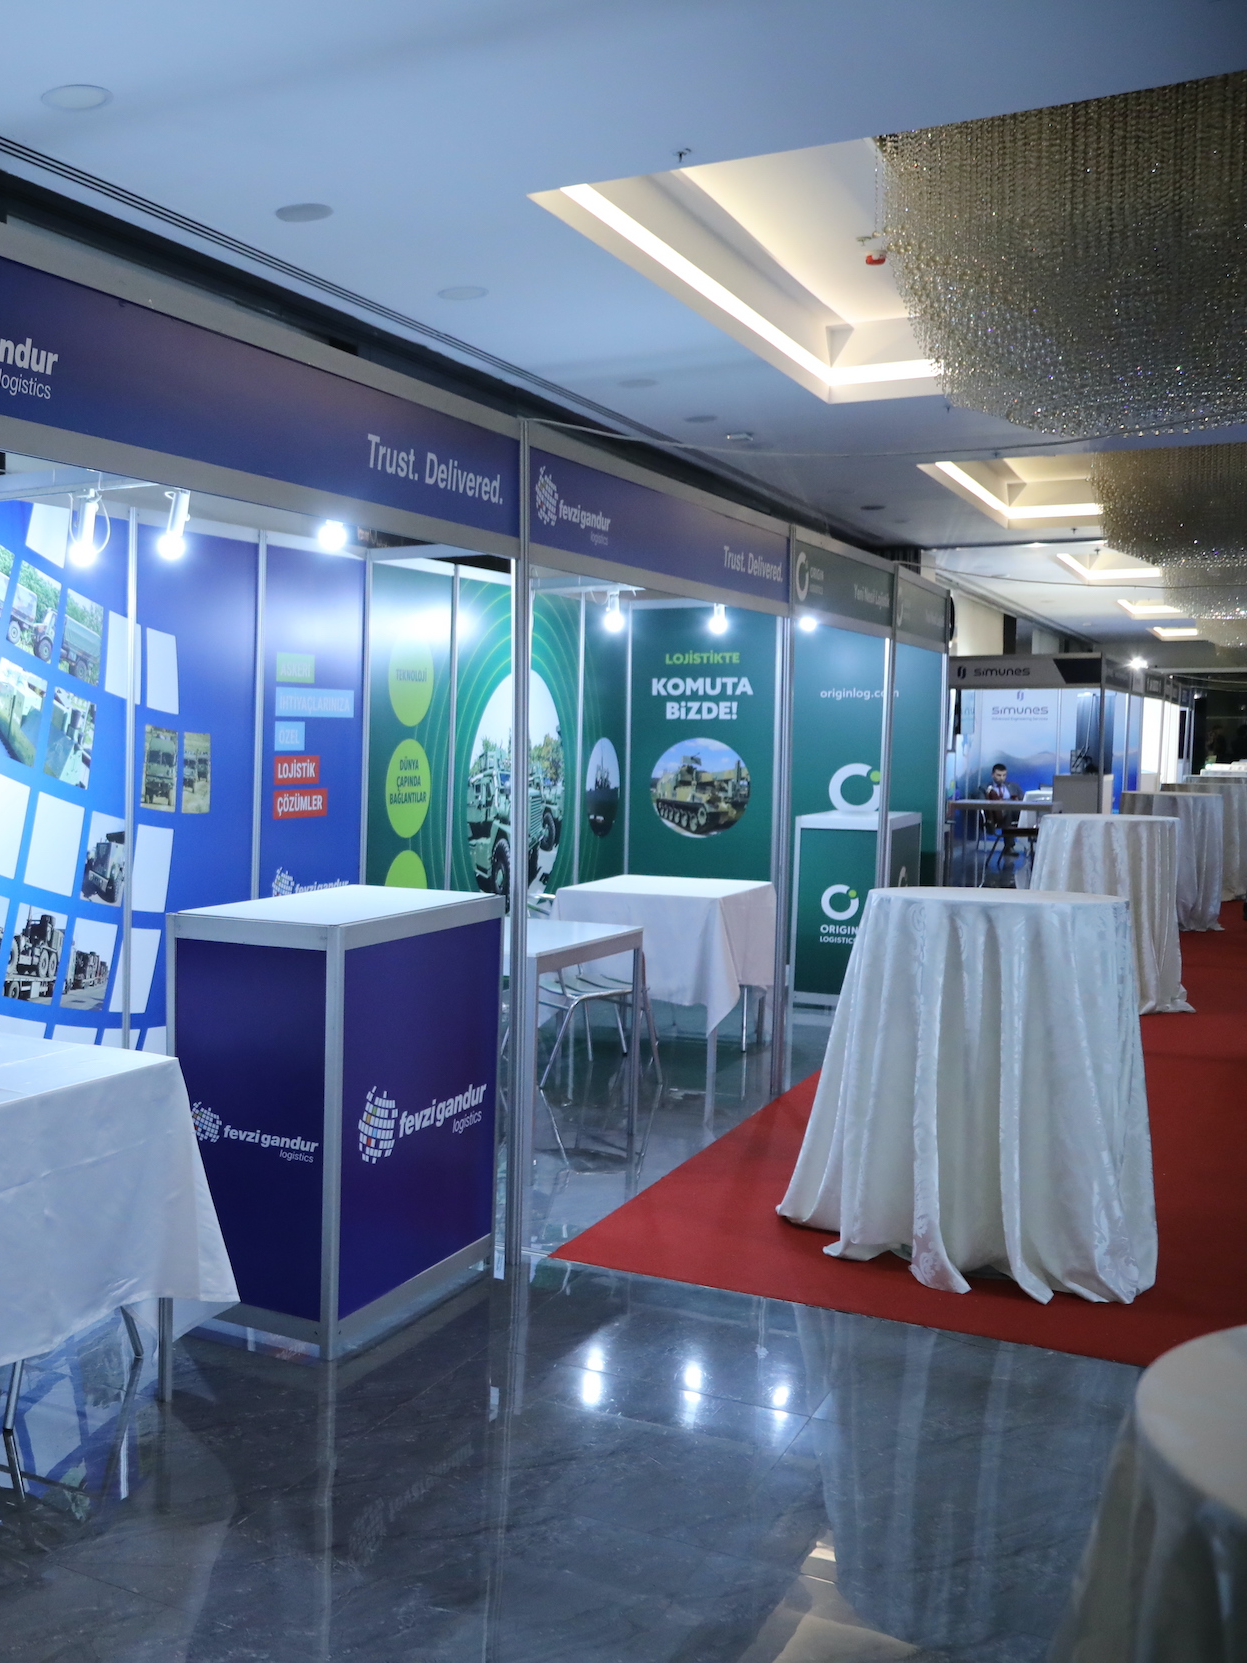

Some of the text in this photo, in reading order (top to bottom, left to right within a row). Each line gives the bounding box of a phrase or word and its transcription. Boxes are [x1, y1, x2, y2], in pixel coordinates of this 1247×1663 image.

[367, 433, 503, 505] Trust. Delivered.
[723, 545, 783, 583] Trust. Delivered.
[665, 650, 740, 665] LOJİSTİKTE
[395, 667, 429, 683] TEKNOLOJİ
[651, 677, 753, 697] KOMUTA
[278, 759, 315, 778] LOJİSTİK
[399, 757, 419, 771] DÜNYA
[396, 776, 421, 791] ÇAPINDA
[277, 793, 323, 816] ÇÖZÜMLER
[389, 790, 427, 805] BAĞLANTILAR
[452, 1110, 482, 1134] logistics
[279, 1149, 314, 1164] logistics
